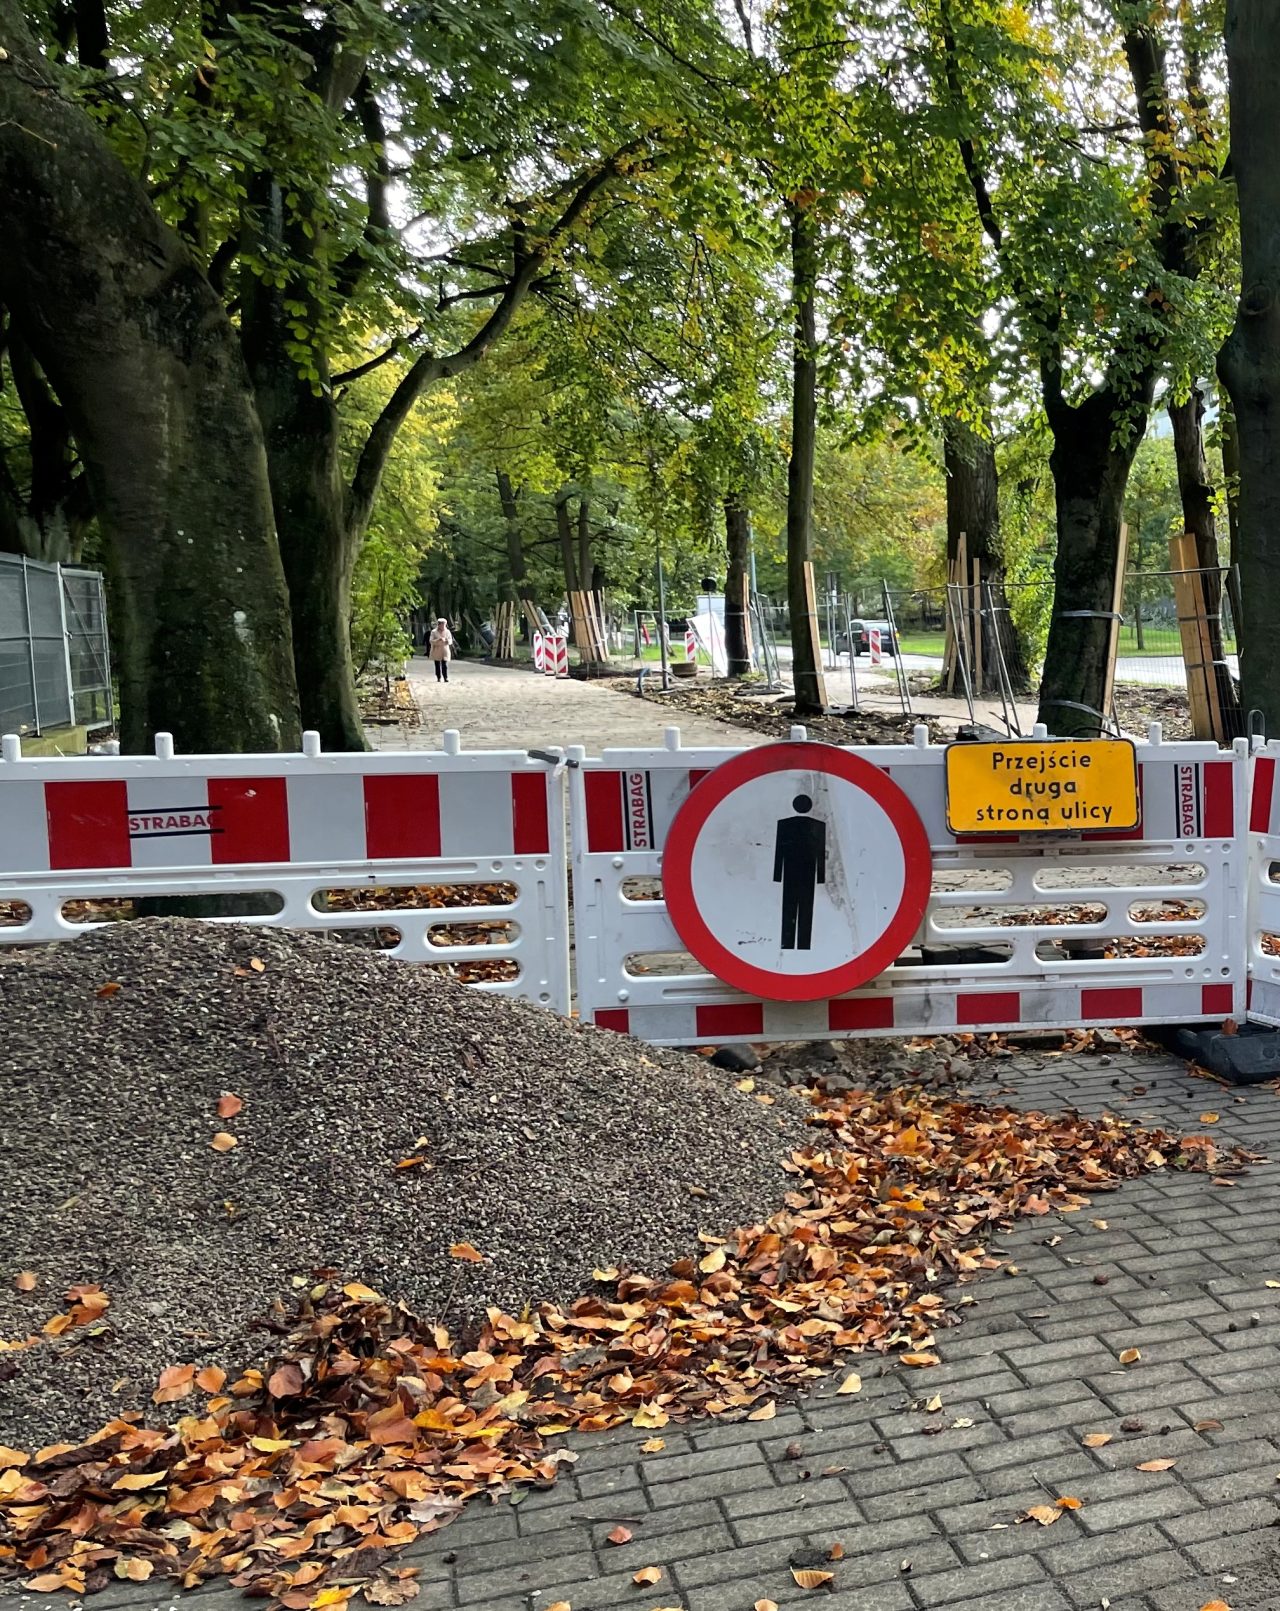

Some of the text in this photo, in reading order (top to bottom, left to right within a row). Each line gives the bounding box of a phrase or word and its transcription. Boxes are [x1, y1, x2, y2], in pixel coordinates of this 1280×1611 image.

[992, 750, 1091, 773] Przejście
[1009, 778, 1077, 799] druga
[630, 773, 647, 848] STRABAG
[1061, 801, 1113, 823] ulicy
[1181, 766, 1195, 836] STRABAG
